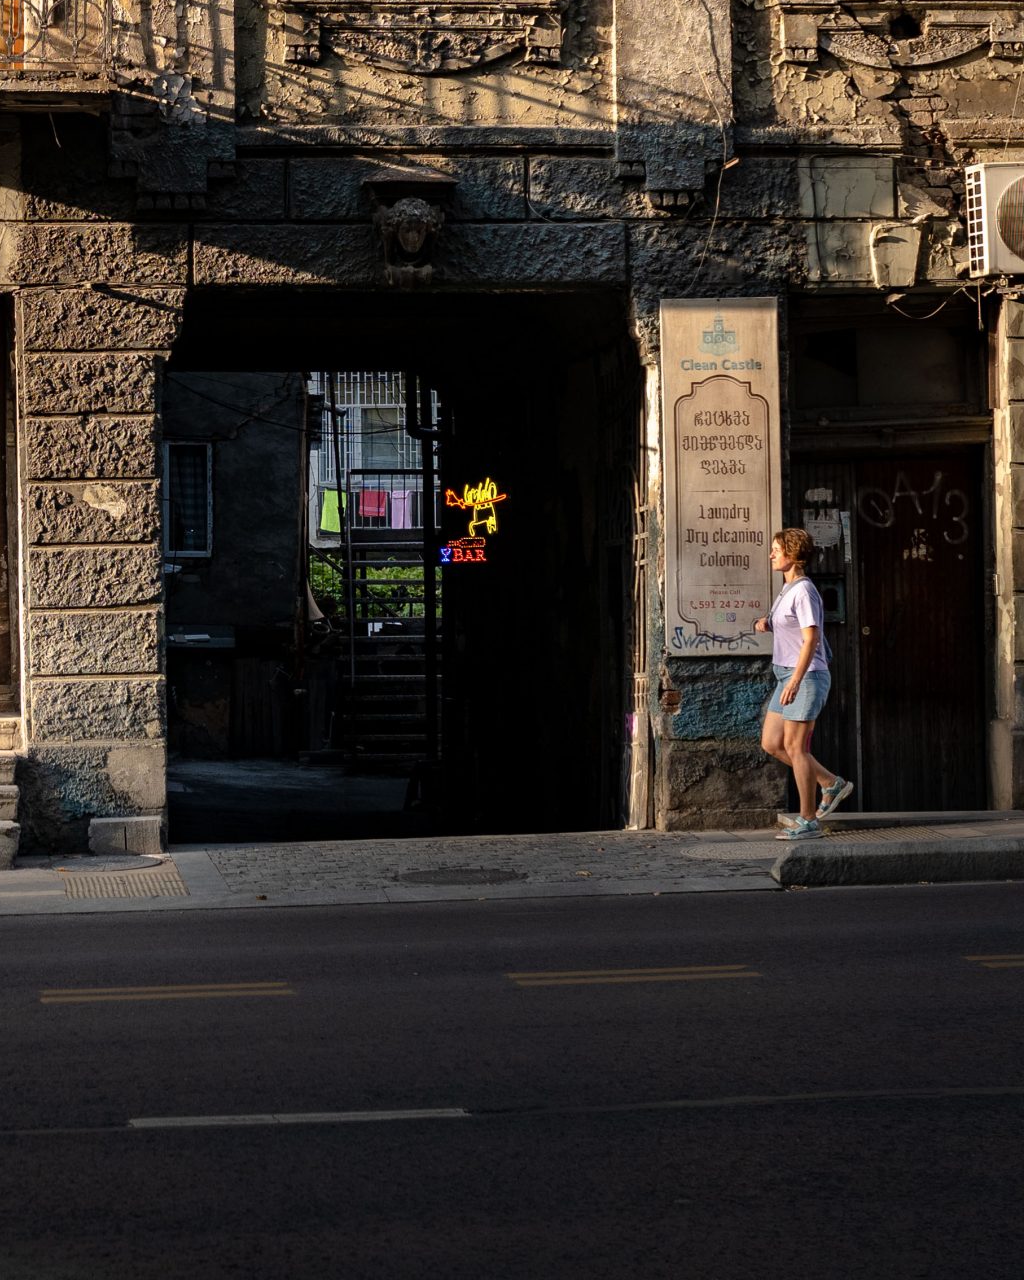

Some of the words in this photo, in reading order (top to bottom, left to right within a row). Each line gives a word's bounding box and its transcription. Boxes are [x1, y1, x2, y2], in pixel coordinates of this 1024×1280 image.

[680, 359, 718, 371] Clean
[721, 359, 762, 371] Castle
[698, 503, 750, 523] Laundry
[685, 528, 709, 546] Dry
[712, 527, 764, 546] cleaning
[452, 548, 487, 562] BAR
[699, 551, 750, 571] Coloring
[698, 600, 716, 609] 591
[719, 600, 731, 609] 24
[734, 600, 746, 609] 27
[748, 600, 761, 609] 40
